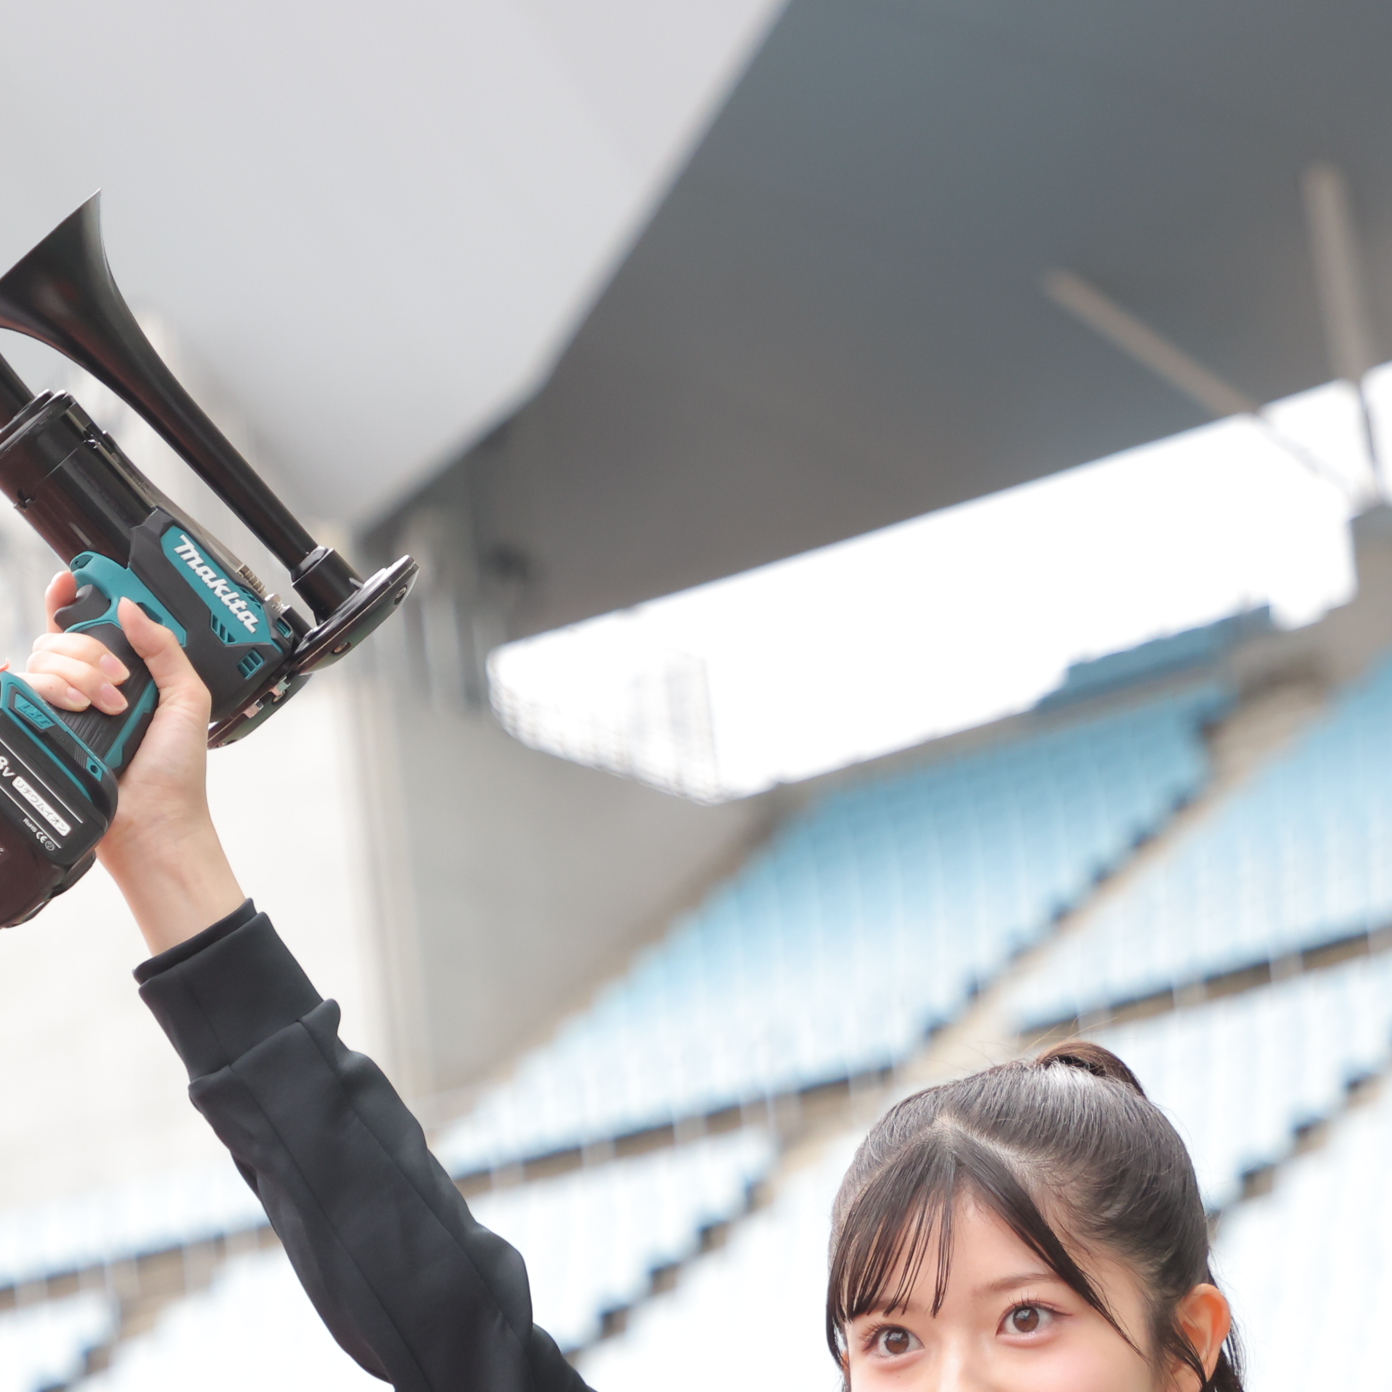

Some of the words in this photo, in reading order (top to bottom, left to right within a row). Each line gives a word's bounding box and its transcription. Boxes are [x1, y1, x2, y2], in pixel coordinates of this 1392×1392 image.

[173, 534, 259, 634] makita
[16, 779, 68, 833] リチウムイオン
[23, 818, 39, 833] RoHS
